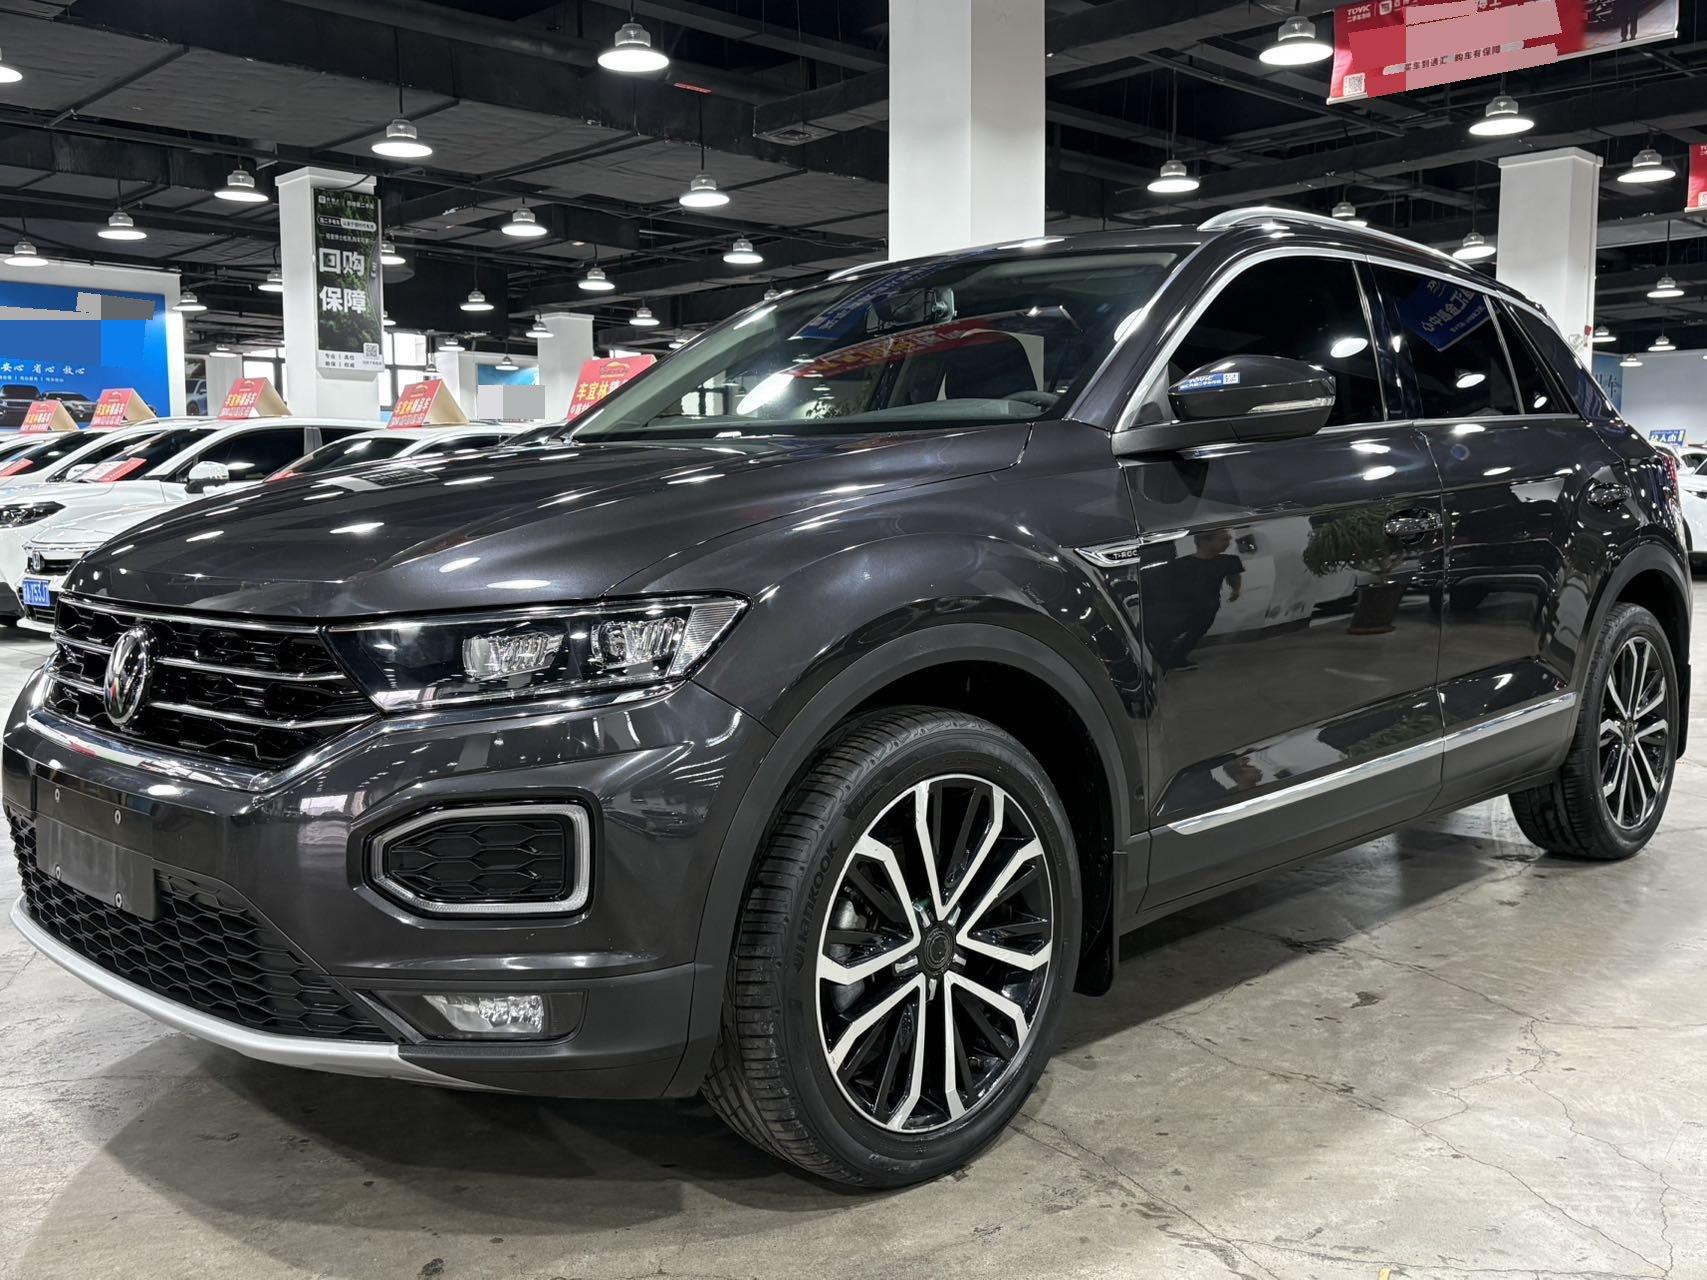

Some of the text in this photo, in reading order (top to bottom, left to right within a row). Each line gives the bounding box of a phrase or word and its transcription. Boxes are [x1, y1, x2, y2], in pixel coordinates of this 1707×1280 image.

[319, 247, 365, 277] 回购
[319, 285, 367, 314] 保障
[1113, 550, 1138, 559] T-ROC
